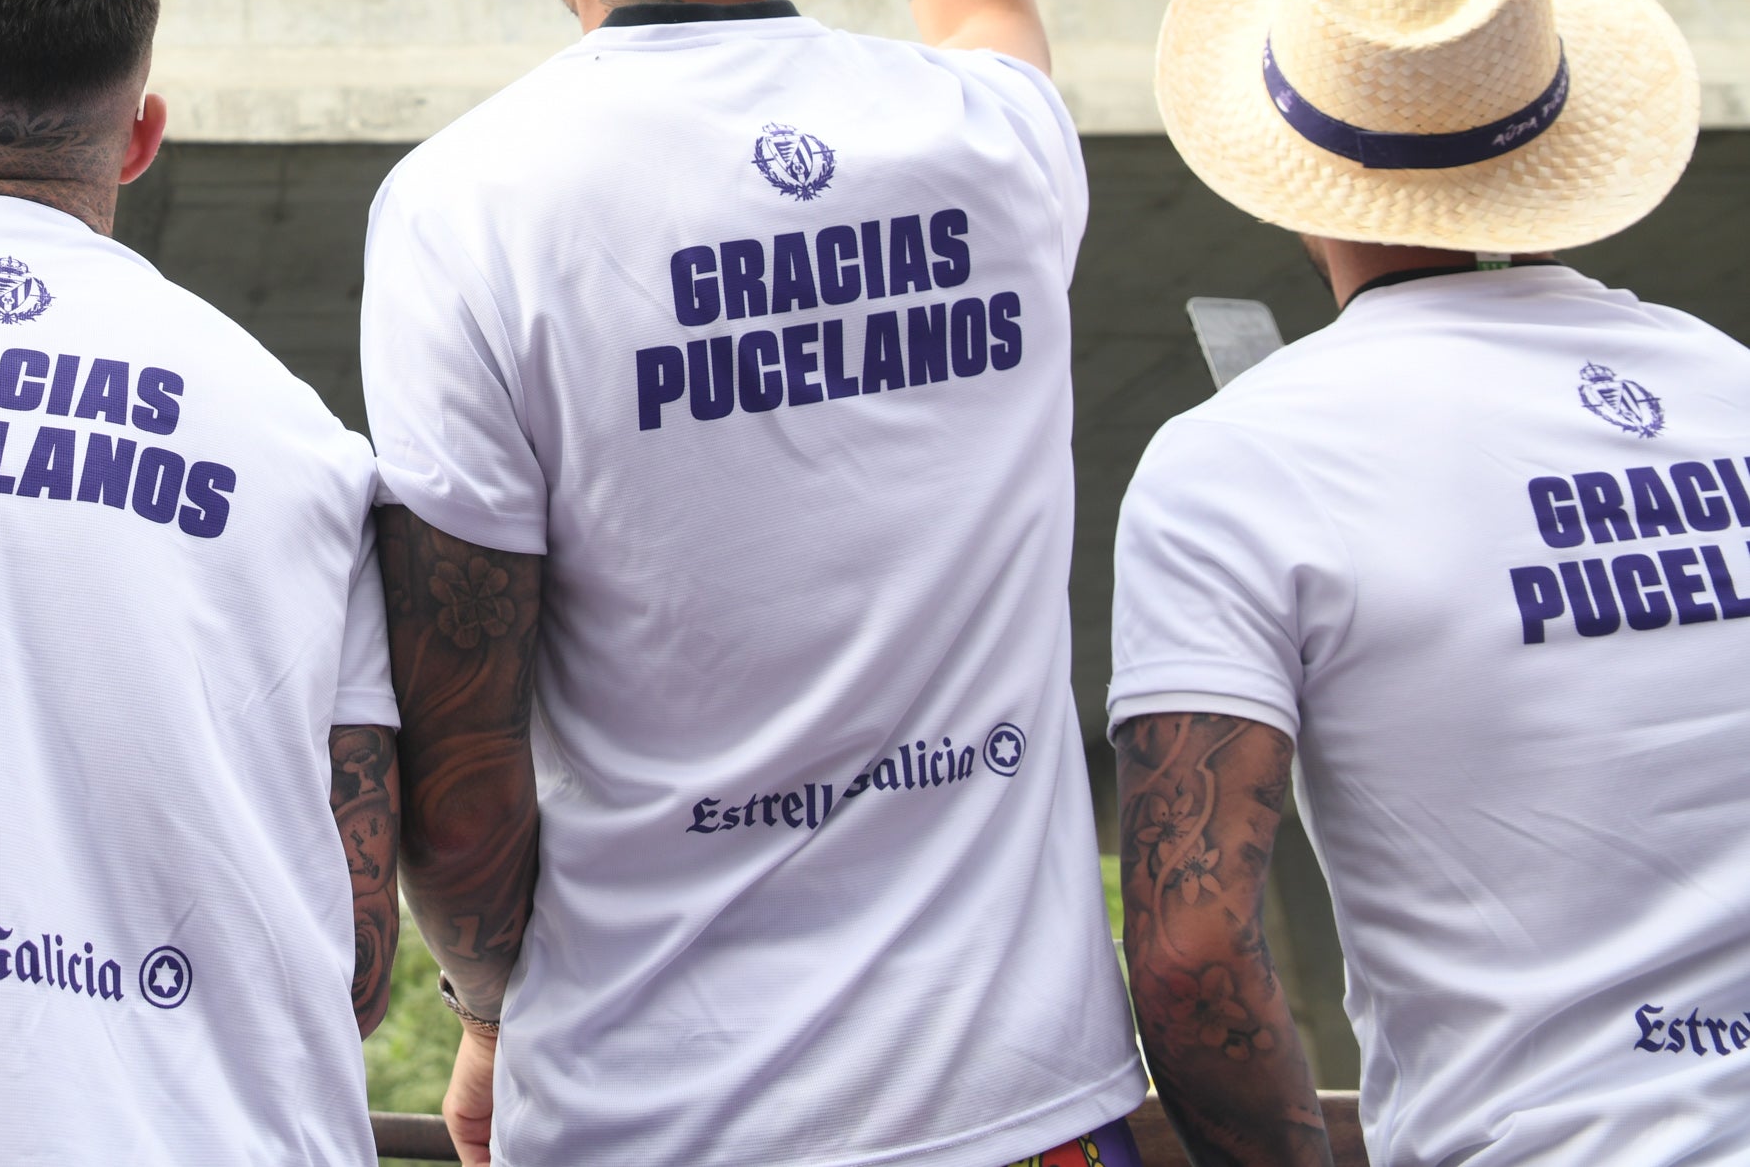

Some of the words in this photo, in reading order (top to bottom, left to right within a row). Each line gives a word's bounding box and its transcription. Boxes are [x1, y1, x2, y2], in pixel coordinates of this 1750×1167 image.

[670, 208, 971, 327] GRACIAS
[635, 291, 1023, 431] PUCELANOS
[1528, 456, 1750, 549] GRACI
[1509, 540, 1750, 645] PUCEL
[685, 782, 834, 834] Estrell
[1634, 1003, 1750, 1057] Estre
